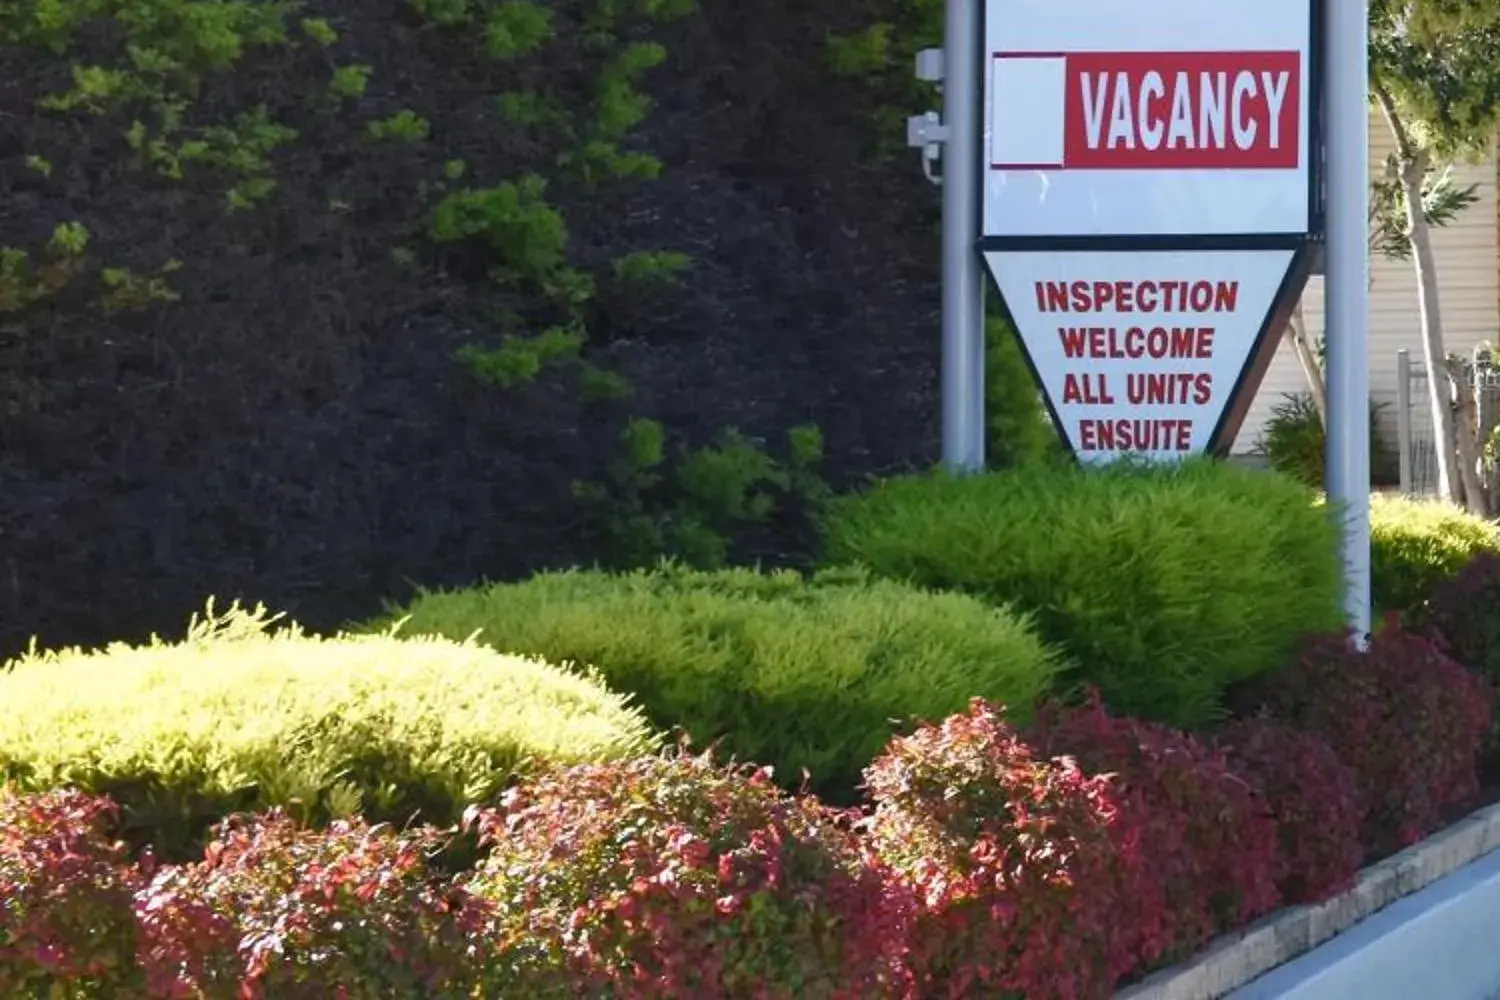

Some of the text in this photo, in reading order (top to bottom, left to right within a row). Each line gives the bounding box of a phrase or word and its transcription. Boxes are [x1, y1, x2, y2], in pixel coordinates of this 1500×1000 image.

[1080, 70, 1290, 151] VACANCY
[1035, 280, 1239, 313] INSPECTION
[1058, 327, 1215, 358] WELCOME
[1063, 373, 1212, 405] ALL UNITS
[1080, 419, 1193, 452] ENSUITE
